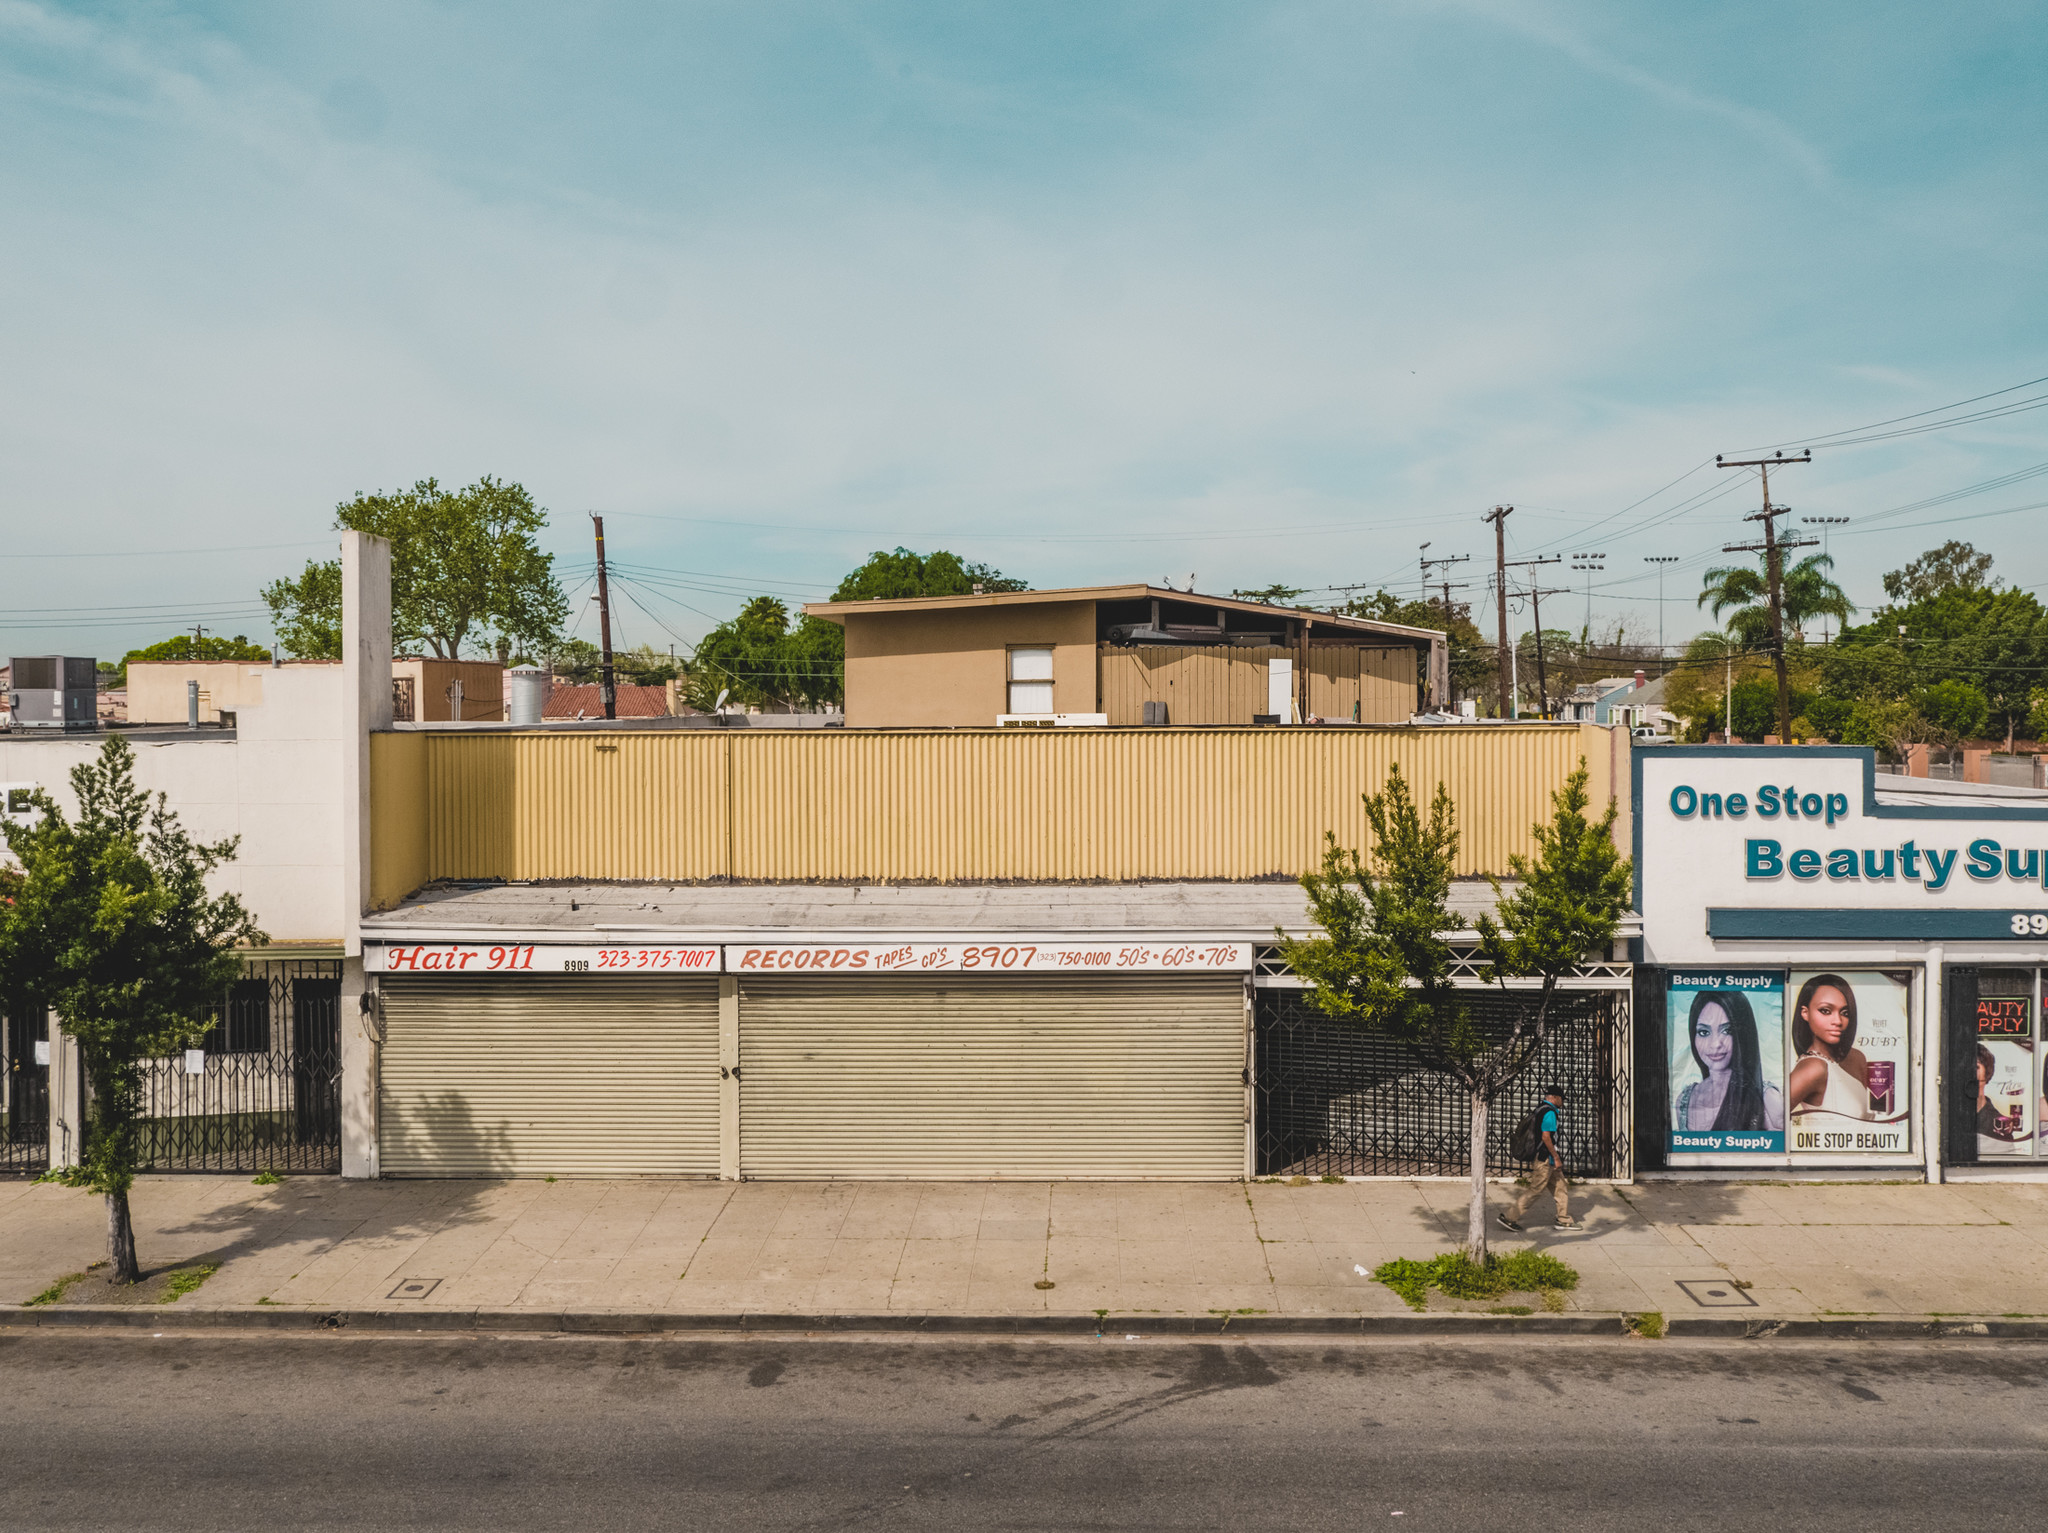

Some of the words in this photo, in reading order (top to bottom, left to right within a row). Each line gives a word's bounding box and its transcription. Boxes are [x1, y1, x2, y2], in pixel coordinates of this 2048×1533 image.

[1669, 785, 1748, 817] One
[1755, 785, 1849, 824] Stop
[1745, 838, 1958, 890] Beauty
[1964, 838, 2048, 892] Su
[388, 946, 478, 970] Hair
[486, 946, 535, 970] 911
[564, 960, 589, 971] 8909
[597, 950, 716, 968] 323-375-7007
[740, 949, 870, 969] RECORDS
[874, 945, 913, 969] TAPES
[921, 947, 948, 968] CD'S
[963, 946, 1037, 968] 8907
[1672, 975, 1721, 988] Beauty
[1725, 975, 1772, 988] Supply
[1857, 1036, 1901, 1047] DUBY
[1673, 1135, 1722, 1149] Beauty
[1725, 1135, 1773, 1149] Supply
[1797, 1133, 1820, 1148] ONE
[1824, 1133, 1853, 1148] STOP
[1856, 1133, 1899, 1148] BEAUTY
